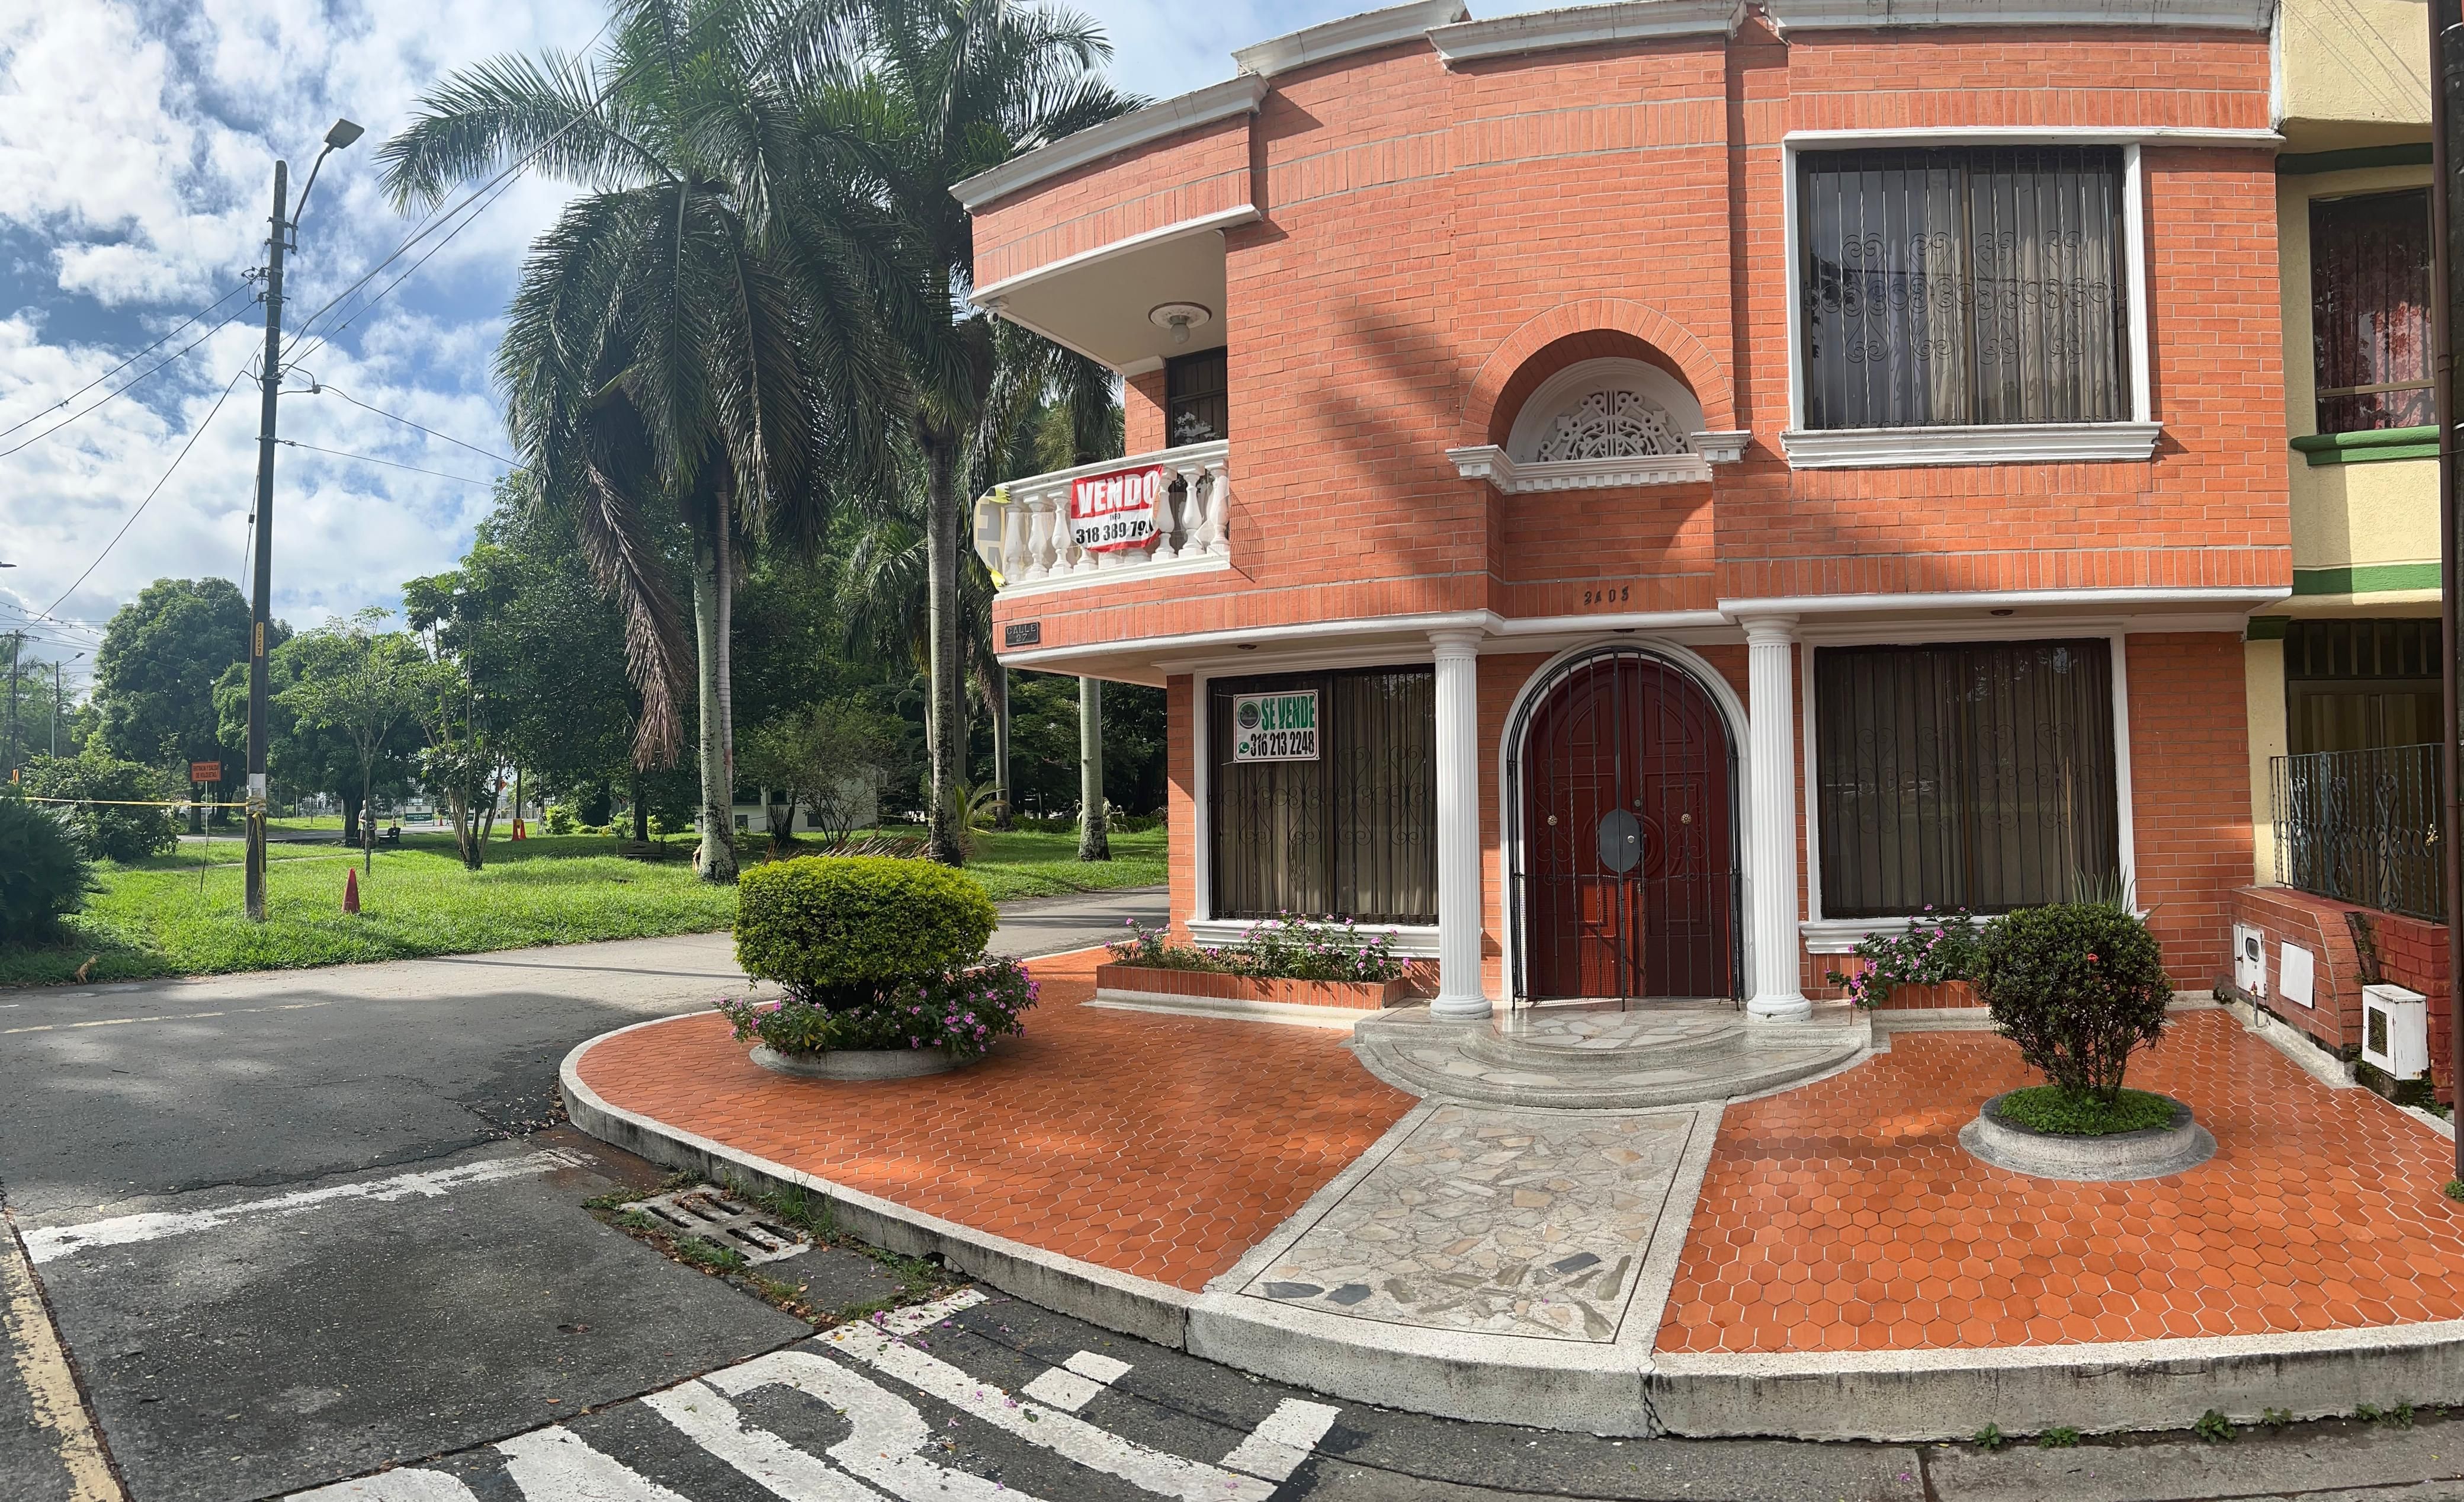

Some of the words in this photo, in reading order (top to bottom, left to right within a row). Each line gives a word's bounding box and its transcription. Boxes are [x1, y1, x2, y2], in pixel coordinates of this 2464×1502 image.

[1077, 470, 1160, 515] VENDO
[1076, 527, 1099, 544] 318
[1103, 522, 1126, 540] 389
[1130, 517, 1153, 536] 79
[1007, 624, 1037, 635] CALLE
[1016, 633, 1028, 642] 27
[1262, 698, 1276, 731] SE
[1278, 696, 1315, 729] VENDE
[1250, 733, 1268, 757] 316
[1270, 731, 1287, 755] 213
[1290, 731, 1315, 755] 2248
